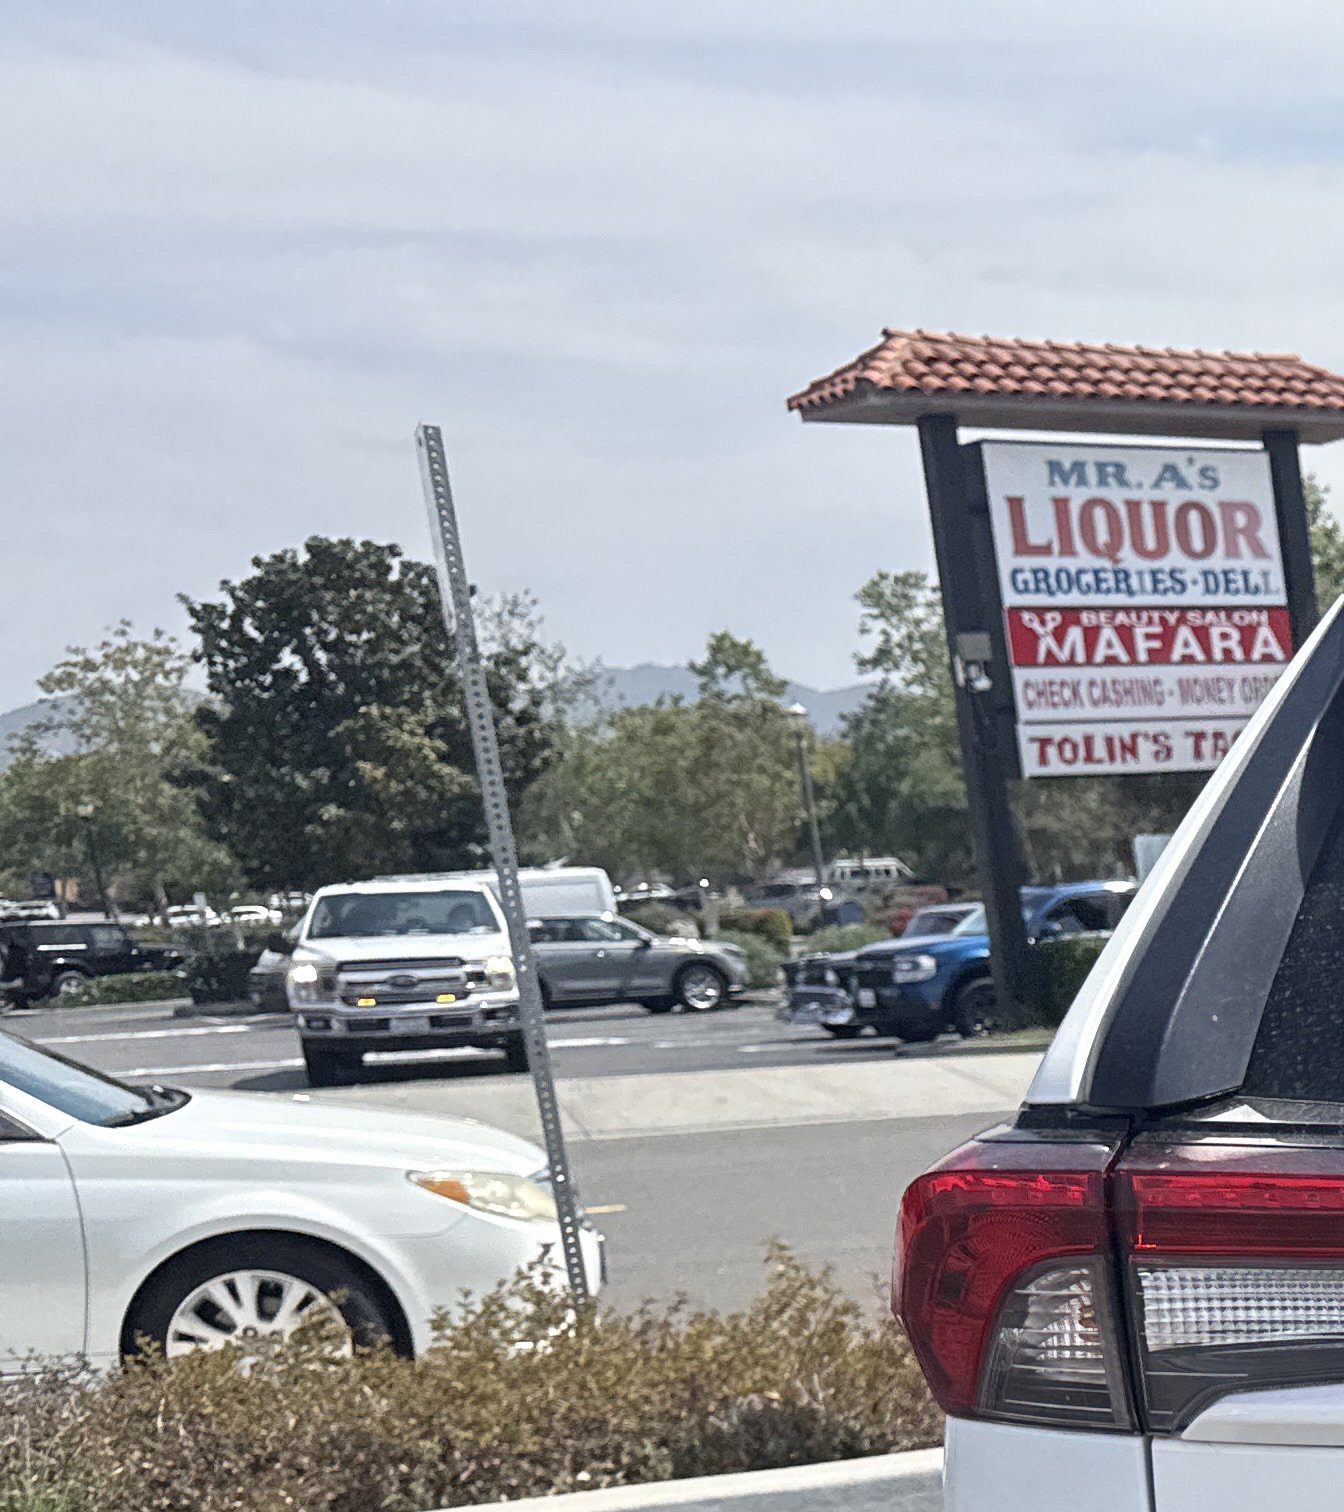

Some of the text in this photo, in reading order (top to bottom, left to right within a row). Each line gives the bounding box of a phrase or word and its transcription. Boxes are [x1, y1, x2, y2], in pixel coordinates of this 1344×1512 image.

[1046, 459, 1144, 489] MR.
[1004, 496, 1272, 564] LIQUOR
[1079, 609, 1268, 628] BEAUTY SALON
[1036, 624, 1286, 664] MAFARA
[1022, 678, 1084, 710] CHECK
[1088, 676, 1166, 708] CASHING
[1177, 675, 1235, 706] MONEY
[1028, 729, 1174, 767] TOLIN'S
